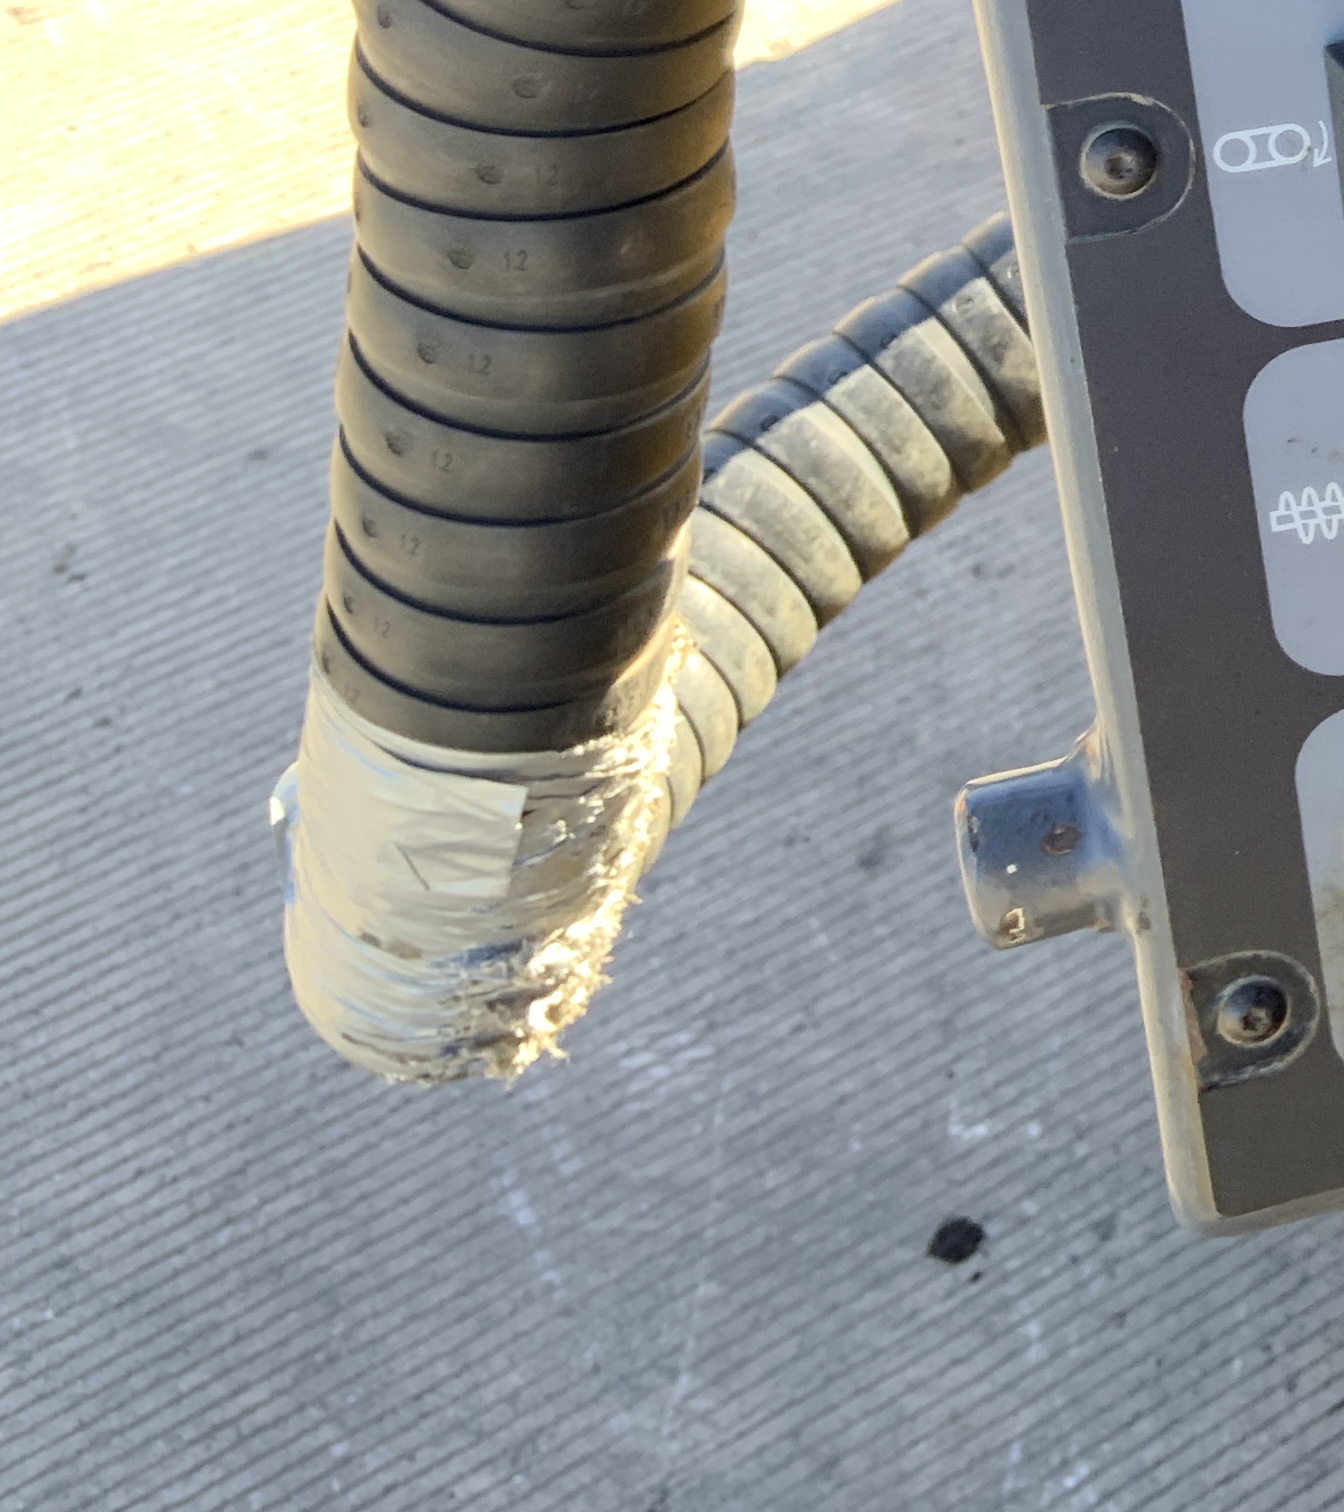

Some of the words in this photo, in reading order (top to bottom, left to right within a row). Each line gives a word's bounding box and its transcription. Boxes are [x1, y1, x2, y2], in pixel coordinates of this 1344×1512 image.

[502, 248, 529, 272] 12
[467, 353, 493, 376] 12
[431, 452, 454, 473] 12
[400, 533, 421, 557] 12
